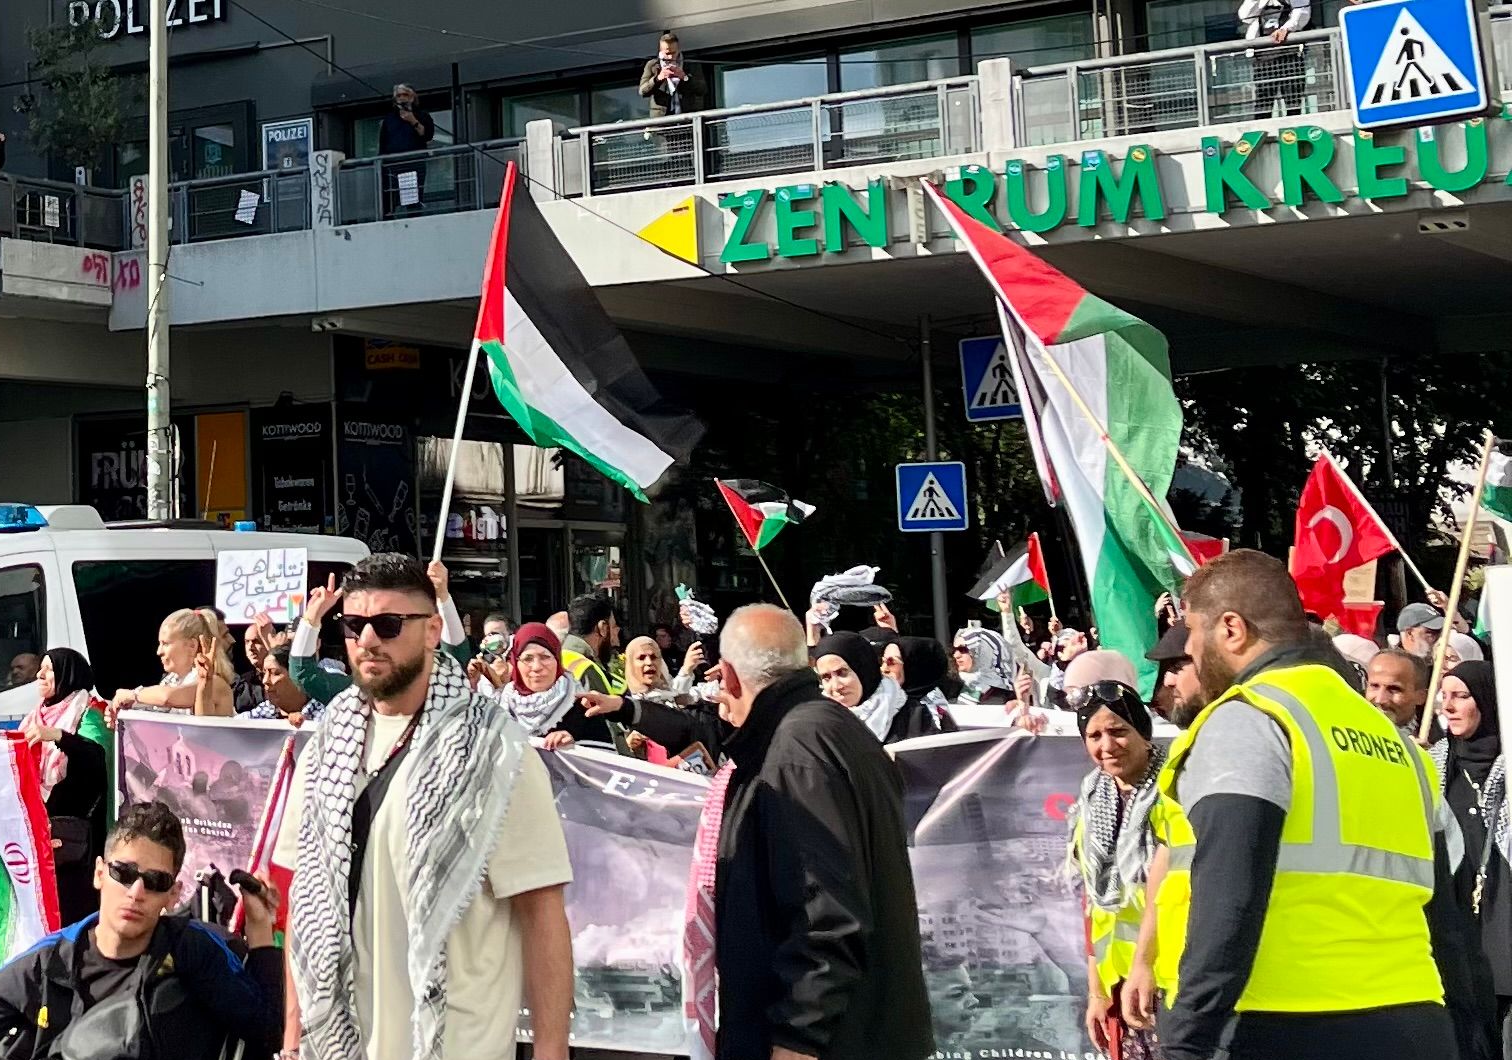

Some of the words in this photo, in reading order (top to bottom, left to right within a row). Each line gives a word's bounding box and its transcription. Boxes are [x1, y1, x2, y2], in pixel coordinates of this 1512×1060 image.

[69, 0, 221, 38] POLZEI
[268, 126, 307, 142] POLIZEI
[1201, 105, 1512, 213] KREU
[1331, 726, 1410, 768] ORDNER
[928, 1051, 972, 1060] bing
[979, 1048, 1053, 1060] Children
